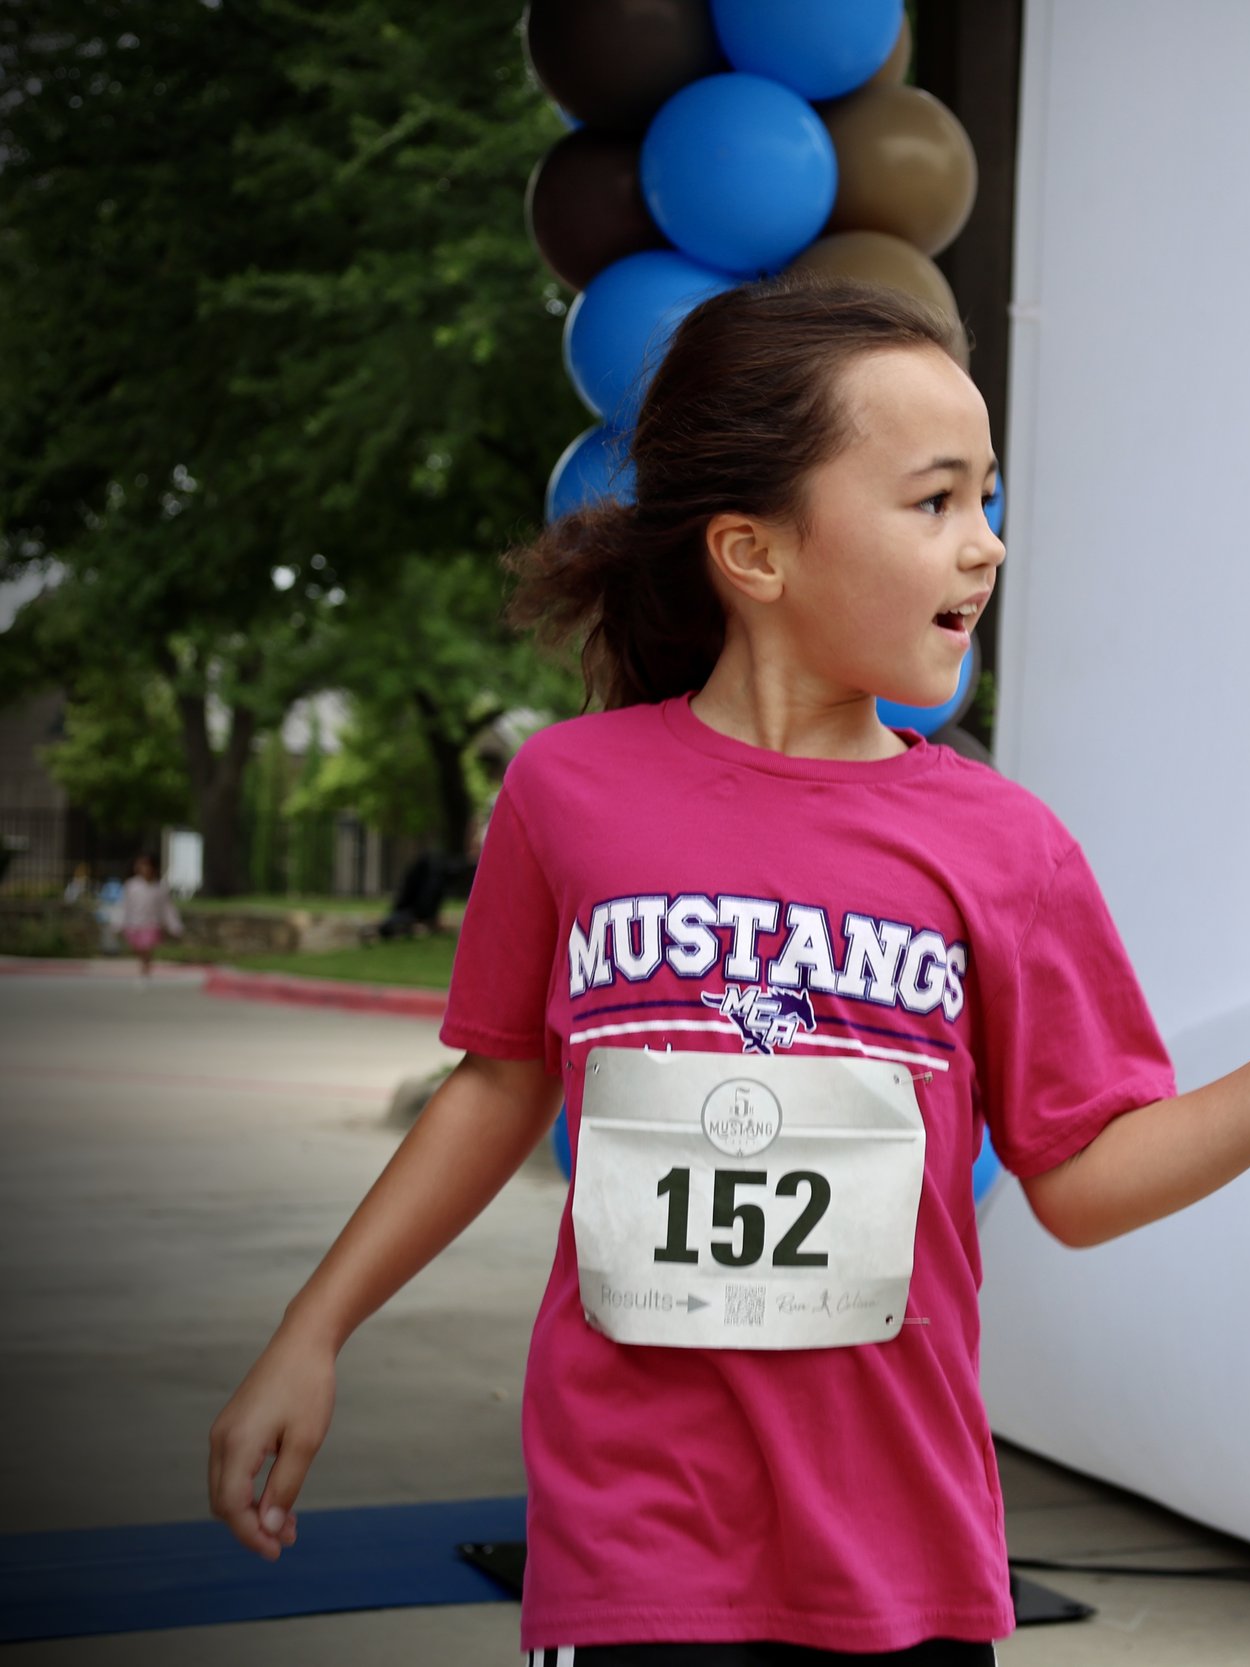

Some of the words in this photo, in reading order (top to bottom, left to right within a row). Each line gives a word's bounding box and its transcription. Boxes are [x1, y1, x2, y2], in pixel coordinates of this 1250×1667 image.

[569, 893, 968, 1022] MUSTANGS
[720, 984, 799, 1049] MCA
[653, 1166, 832, 1268] 152
[601, 1284, 673, 1312] Results
